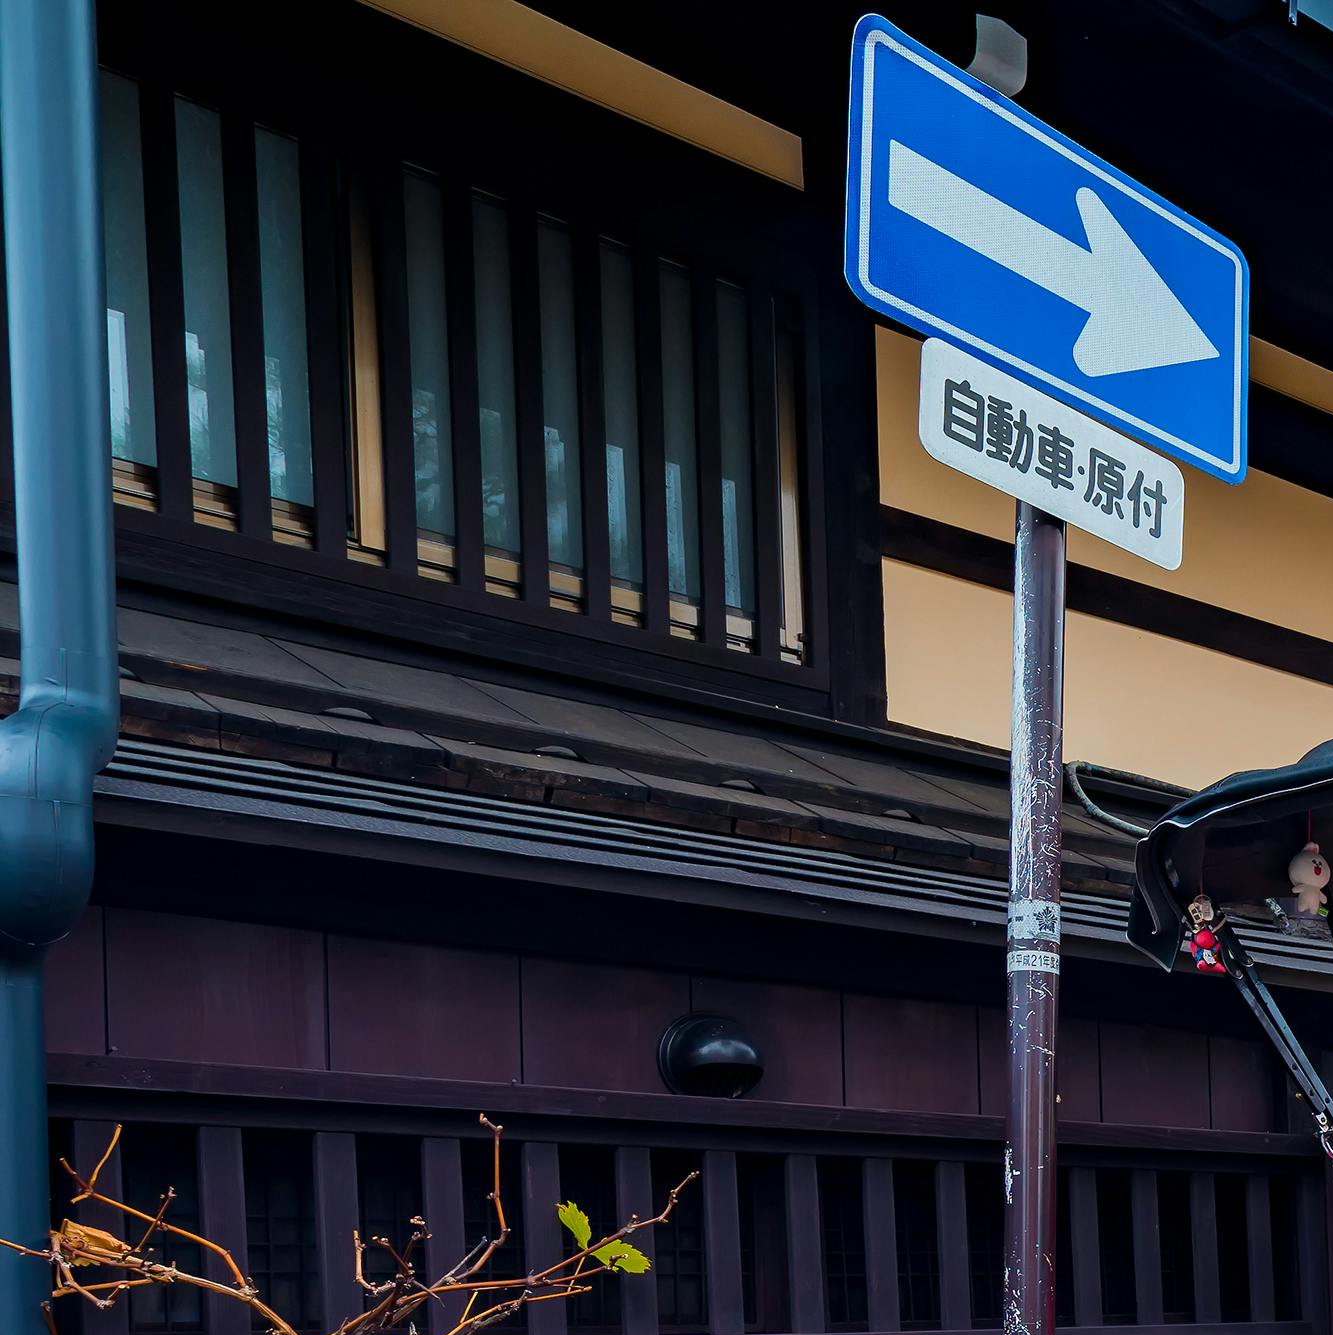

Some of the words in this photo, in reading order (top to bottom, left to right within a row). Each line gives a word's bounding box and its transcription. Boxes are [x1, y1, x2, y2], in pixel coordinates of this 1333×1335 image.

[943, 379, 1168, 539] 自動車・原付
